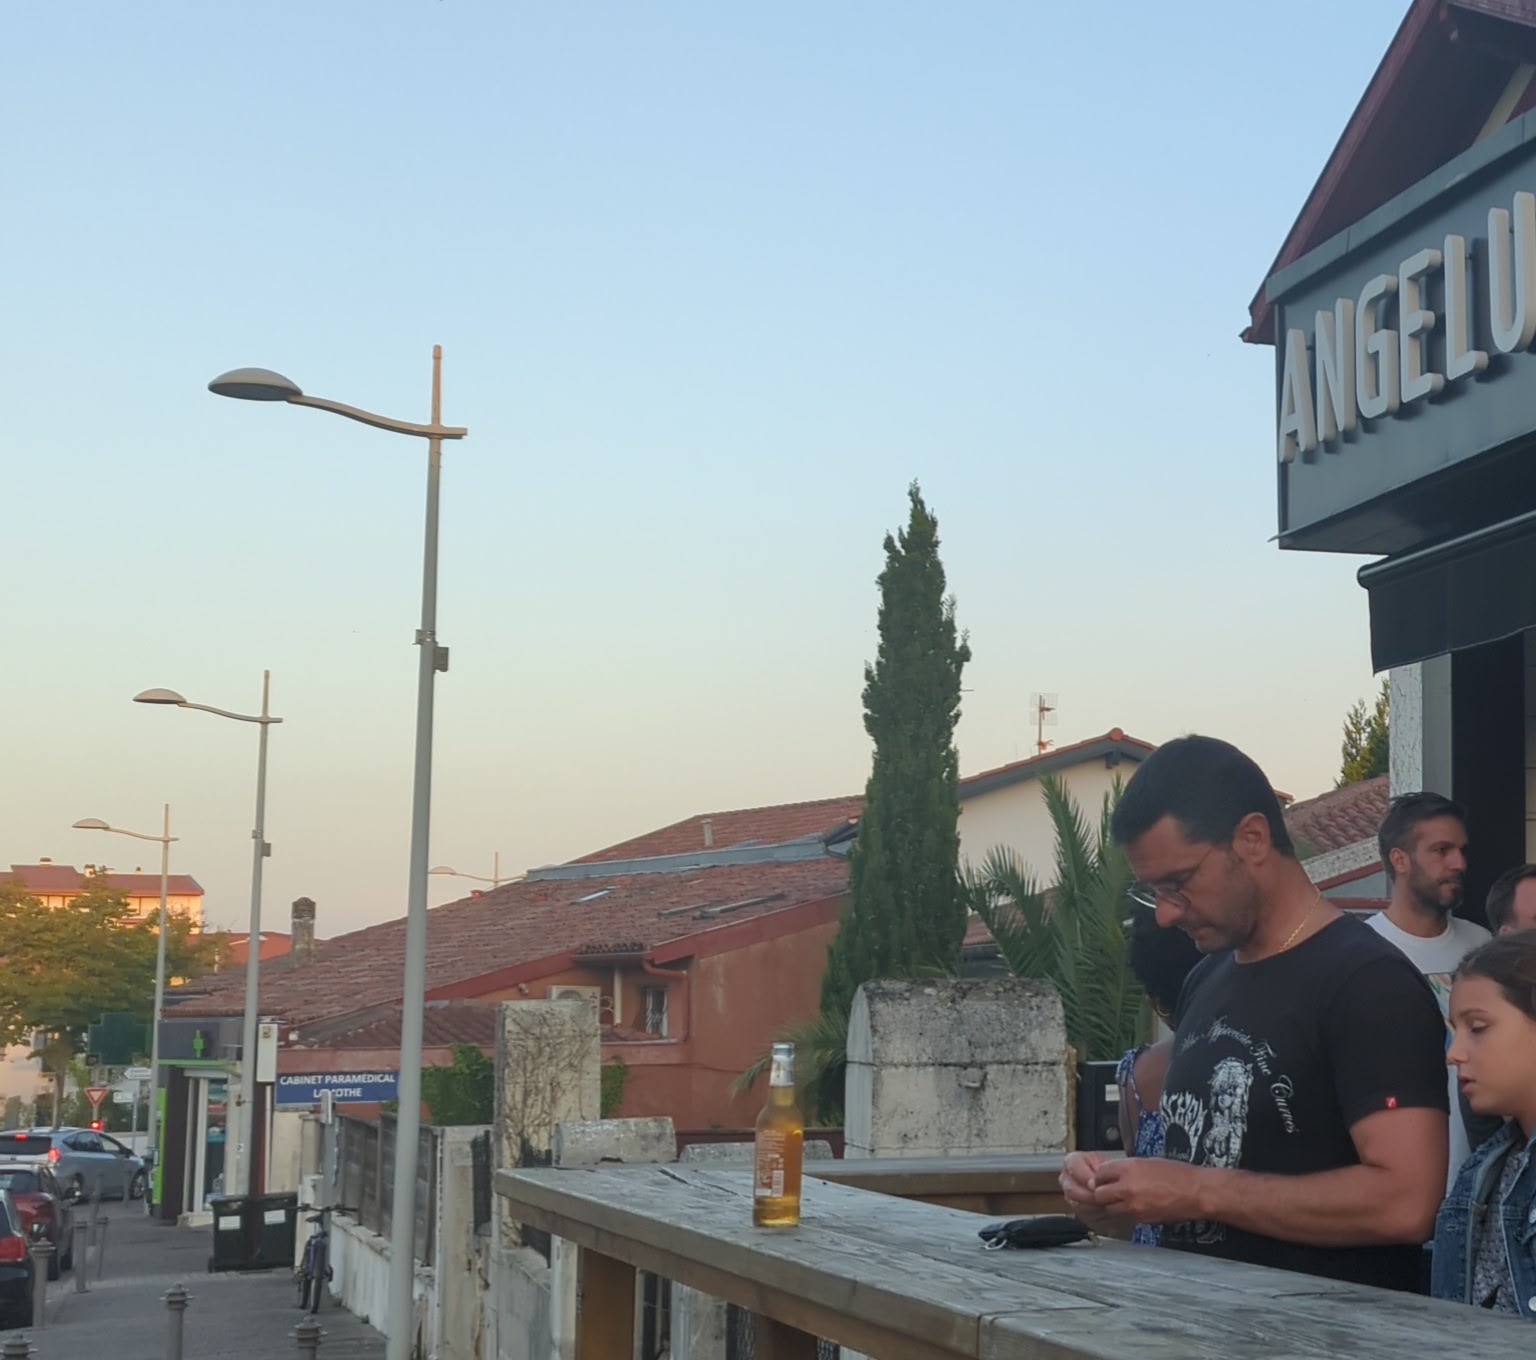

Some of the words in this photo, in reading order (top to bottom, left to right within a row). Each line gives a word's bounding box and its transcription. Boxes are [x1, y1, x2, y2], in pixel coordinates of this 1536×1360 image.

[279, 1075, 323, 1085] CABINET
[325, 1073, 395, 1084] PARAMEDICAL
[313, 1087, 362, 1098] LOTHE
